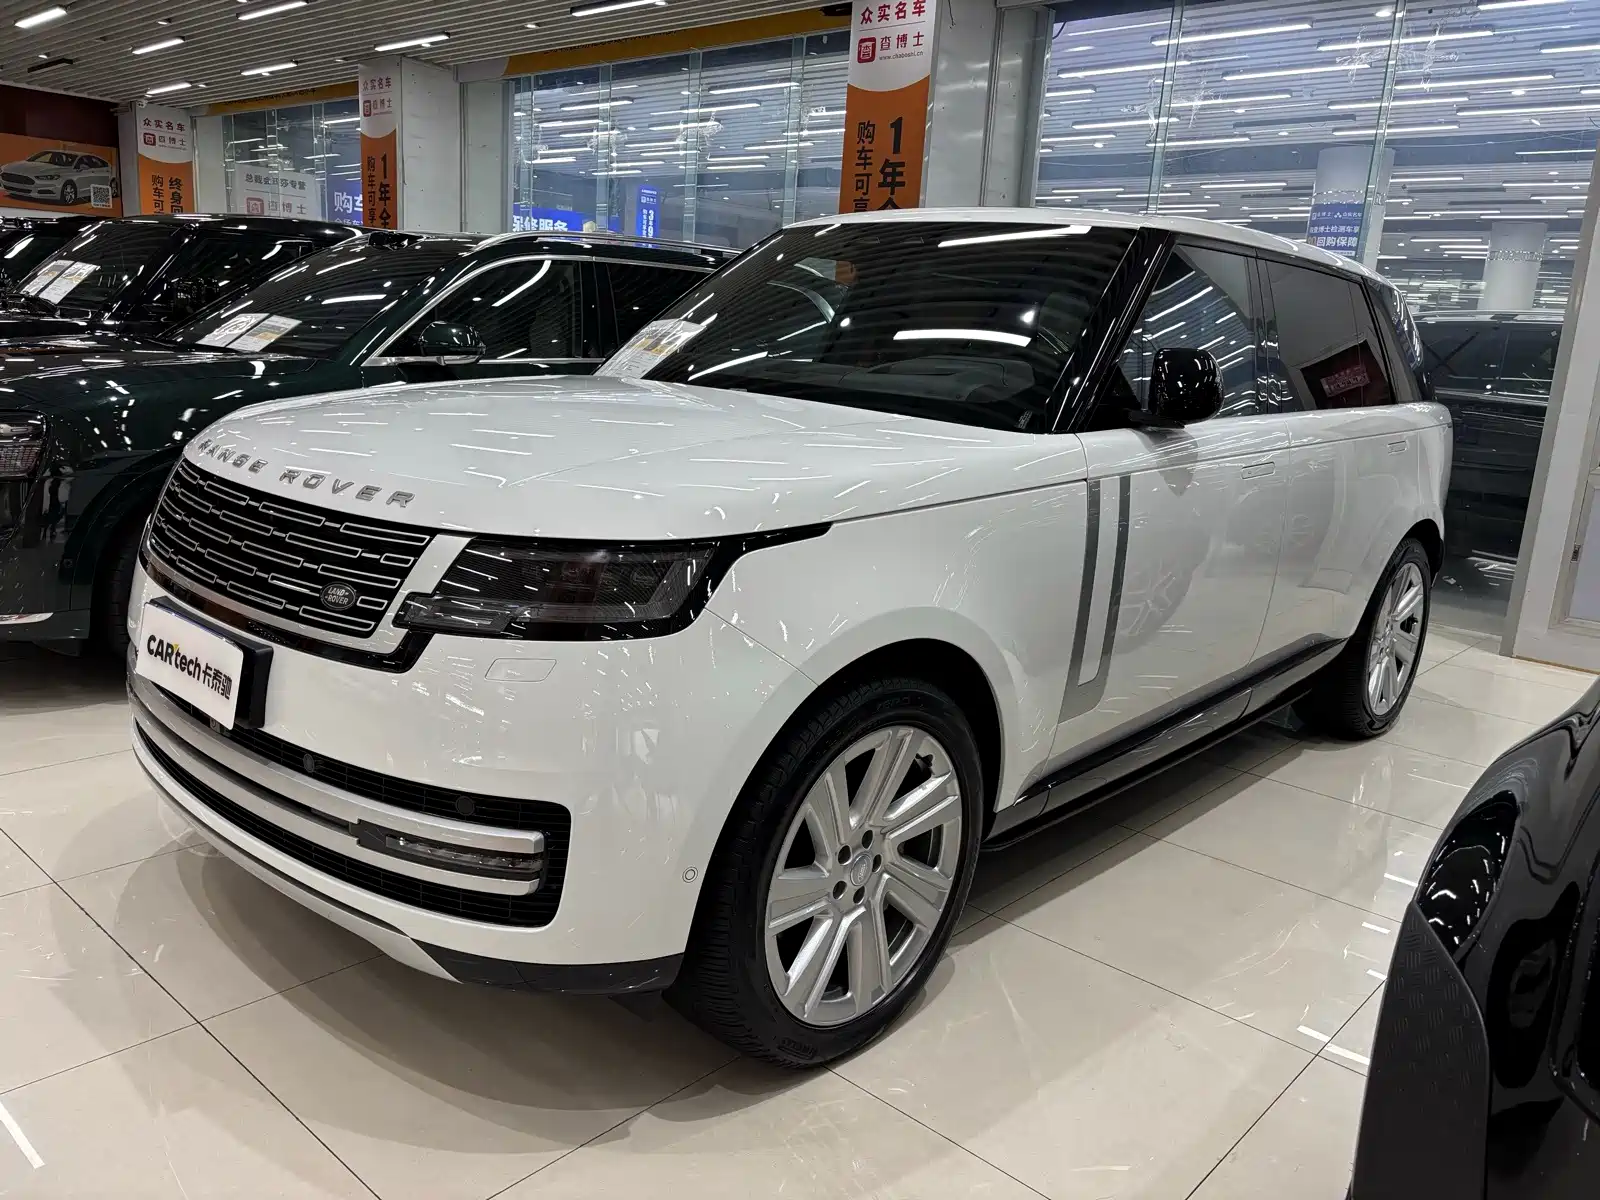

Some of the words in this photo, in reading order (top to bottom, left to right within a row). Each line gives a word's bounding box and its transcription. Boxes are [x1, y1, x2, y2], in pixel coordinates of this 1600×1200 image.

[860, 0, 926, 24] 众实名车
[880, 32, 924, 51] 查博士
[143, 117, 186, 132] 众实名车
[151, 174, 165, 215] 购车可
[197, 438, 269, 474] RANGE
[278, 469, 416, 508] ROVER
[327, 586, 346, 597] LAND
[327, 594, 349, 605] ROVER
